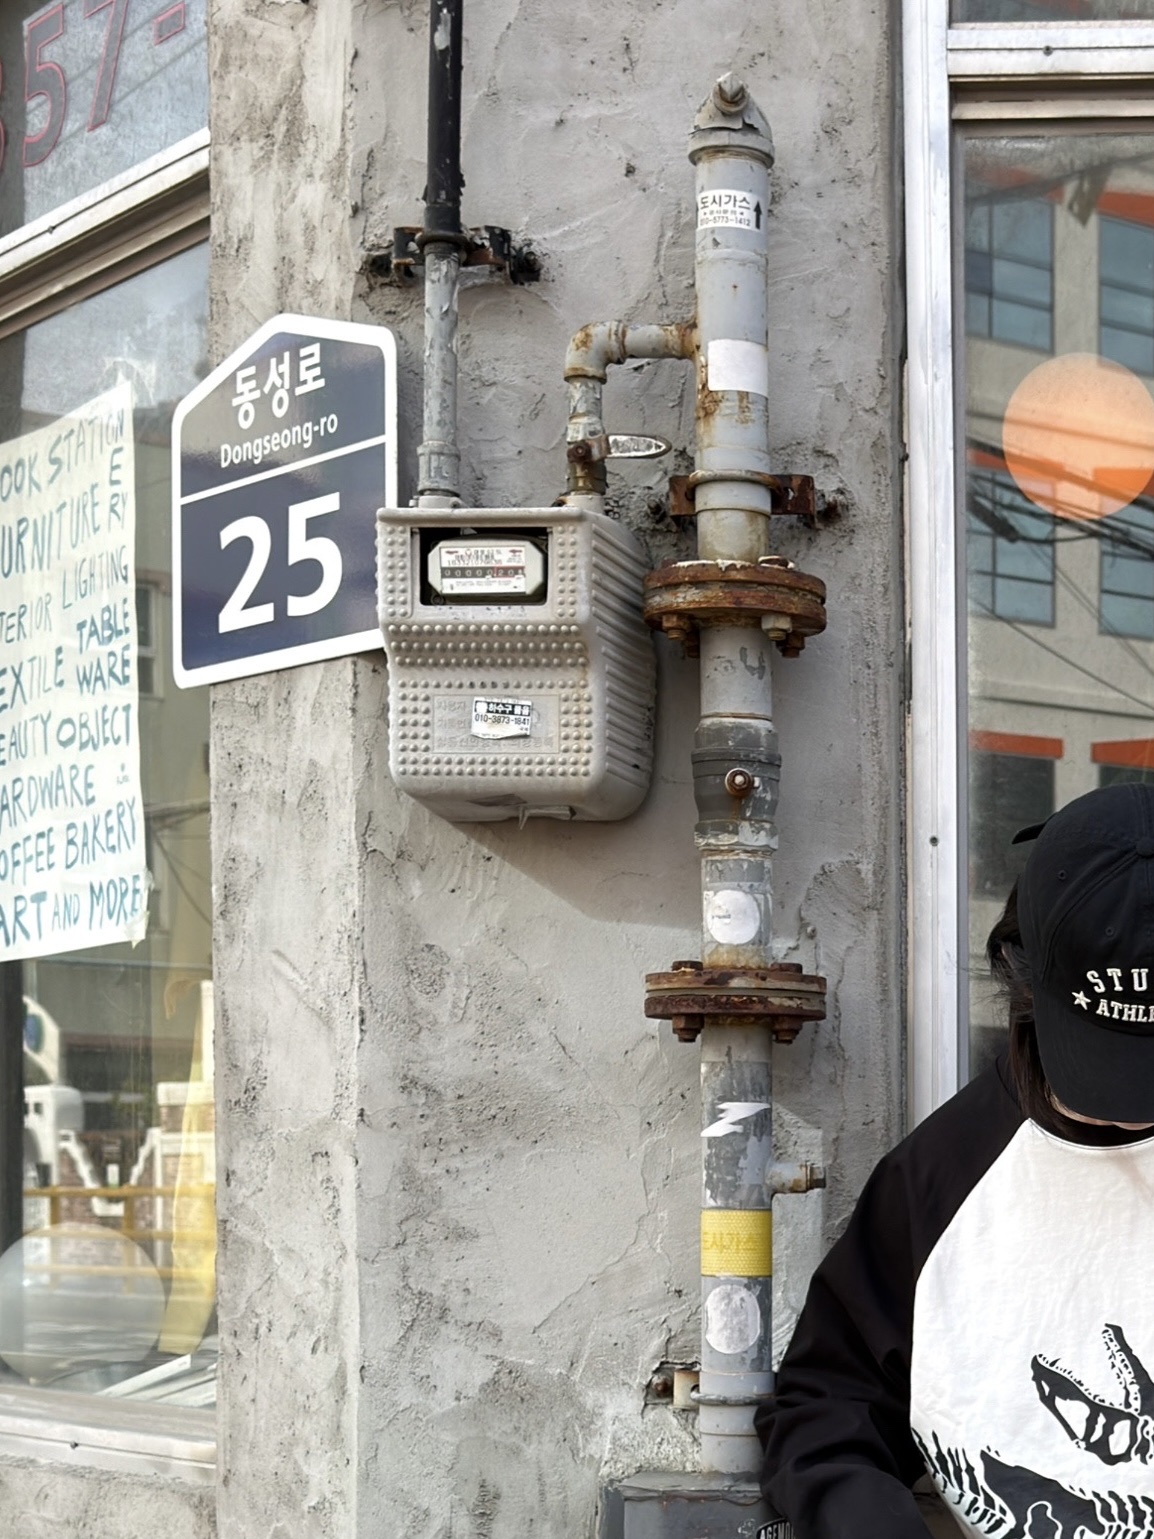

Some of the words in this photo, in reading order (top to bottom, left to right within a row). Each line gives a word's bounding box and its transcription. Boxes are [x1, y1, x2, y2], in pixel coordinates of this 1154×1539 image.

[700, 194, 751, 210] 도시가스
[232, 342, 326, 430] 동성로
[220, 413, 339, 469] Dongseong-ro
[62, 544, 129, 610] LIGHTING
[218, 491, 343, 634] 25
[77, 597, 130, 654] TABLE
[76, 643, 131, 695] WARE
[56, 703, 132, 752] OBJECT
[65, 796, 137, 870] BAKERY
[0, 891, 48, 948] ART
[52, 891, 81, 932] AND
[89, 873, 142, 931] MORE
